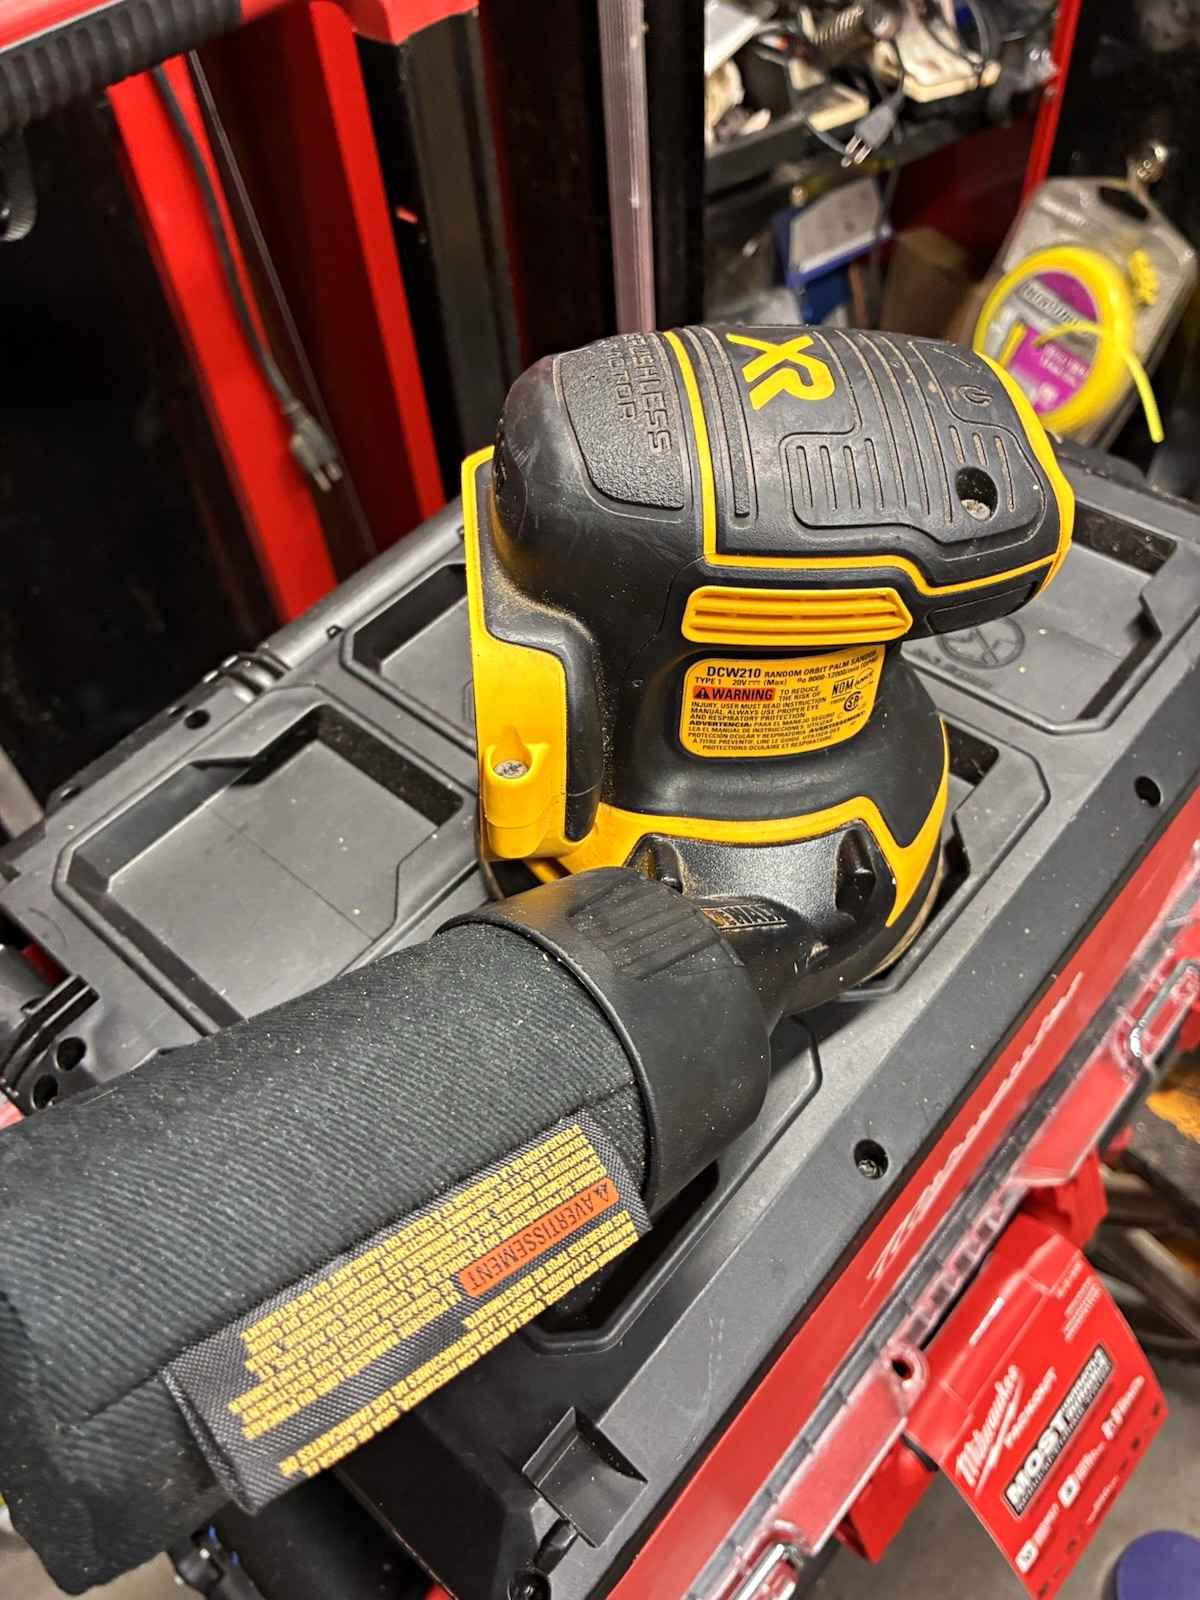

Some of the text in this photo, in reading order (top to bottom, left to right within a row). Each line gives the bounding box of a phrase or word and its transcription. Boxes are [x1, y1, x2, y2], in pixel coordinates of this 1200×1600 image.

[725, 333, 835, 411] XR
[707, 649, 877, 679] DCW210 RANDOM ORBIT PALM SANDER
[695, 676, 716, 684] TYPE
[763, 678, 787, 687] (Max)
[792, 685, 819, 694] REDUCE
[831, 678, 855, 696] NOM
[712, 688, 774, 701] WARNING
[782, 697, 827, 708] INSTRUCTION
[777, 705, 806, 714] PROPER
[782, 717, 810, 726] MANEJO
[811, 712, 836, 721] SEGURO
[497, 1165, 514, 1180] LA
[508, 1157, 526, 1173] DE
[542, 1143, 595, 1180] PROVOQUER
[450, 1172, 502, 1209] PONCEUSE
[529, 1172, 548, 1189] UN
[558, 1185, 575, 1201] DU
[438, 1201, 455, 1216] ET
[508, 1194, 537, 1217] DANS
[397, 1215, 434, 1242] CELLES
[466, 1208, 492, 1229] AFIN
[477, 1217, 501, 1237] SAC
[496, 1210, 513, 1225] LE
[610, 1208, 631, 1227] LOS
[451, 1222, 470, 1239] DE
[565, 1219, 616, 1258] DIFERENTES
[597, 1219, 636, 1250] MANUAL
[244, 1132, 589, 1356] SOUVENT LE SAC ET SE CONFORMER STRICTEMENT AUX DIRECTIVES DU GUIDE
[382, 1234, 402, 1252] DU
[401, 1231, 456, 1271] MINIMISER
[462, 1192, 599, 1292] AVERTISSEMENT
[468, 1241, 486, 1258] DE
[586, 1243, 601, 1258] DE
[595, 1230, 640, 1267] DISMINUIR
[325, 1244, 387, 1287] FABRICANT
[542, 1250, 571, 1274] TIPOS
[576, 1250, 591, 1265] LA
[383, 1263, 407, 1282] LES
[392, 1274, 411, 1291] LA
[406, 1265, 425, 1283] DE
[530, 1266, 548, 1282] DE
[571, 1260, 600, 1284] DICHO
[309, 1279, 331, 1298] DU
[341, 1274, 389, 1309] RISQUES
[436, 1278, 455, 1295] DE
[444, 1289, 463, 1306] LA
[340, 1283, 398, 1326] PONCEUSE
[376, 1290, 411, 1318] ENTRE
[389, 1287, 441, 1327] SURFACES
[494, 1290, 536, 1323] RESPETE
[322, 1318, 345, 1338] OU
[476, 1315, 500, 1336] LAS
[504, 1317, 522, 1333] LA
[339, 1318, 395, 1360] ENDUITES
[475, 1325, 510, 1355] BOLSA
[242, 1342, 284, 1373] VIDER
[304, 1339, 338, 1366] PEUT
[404, 1328, 482, 1388] INSTRUCCIONES
[454, 1347, 481, 1370] CON
[255, 1363, 275, 1381] ET
[312, 1369, 346, 1397] LORS
[294, 1387, 319, 1409] DU
[389, 1380, 410, 1399] DE
[368, 1390, 395, 1414] LOS
[1002, 1365, 1058, 1450] PACKOUT
[369, 1404, 402, 1432] SIGA
[954, 1363, 1020, 1487] Milwaukee
[293, 1404, 375, 1466] FABRICANTES
[353, 1423, 375, 1443] DE
[316, 1434, 359, 1468] CERCA
[1004, 1409, 1069, 1507] MOST
[275, 1453, 302, 1478] DE
